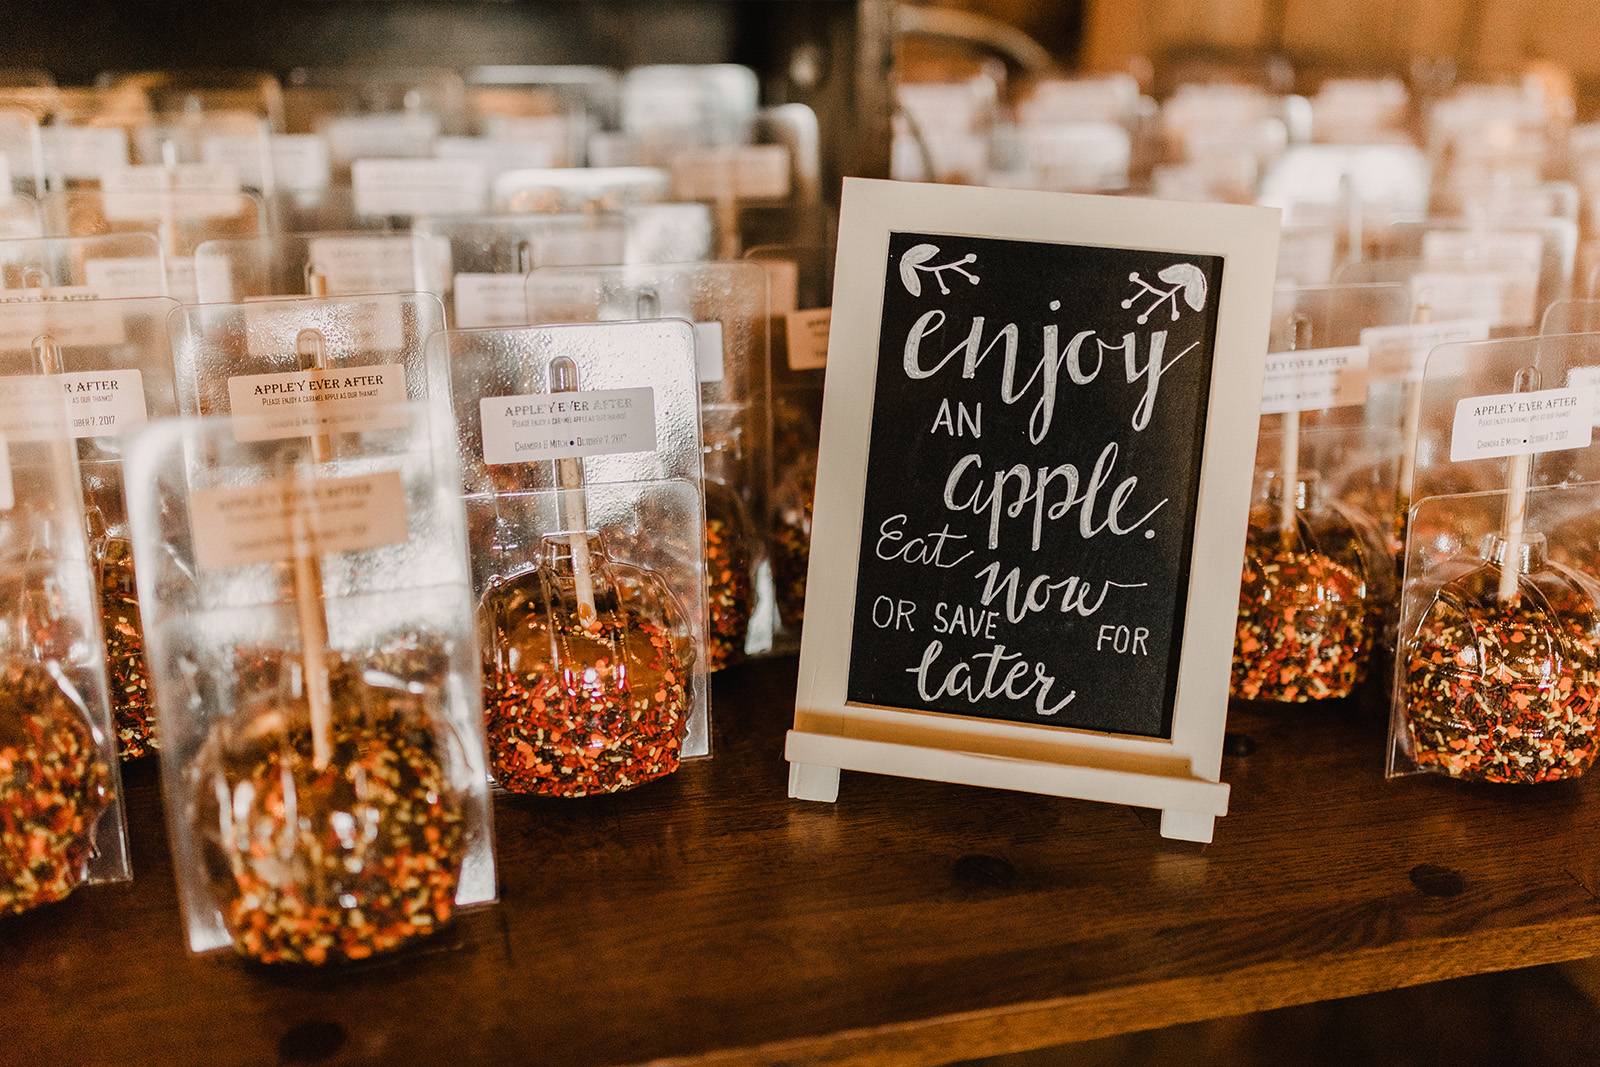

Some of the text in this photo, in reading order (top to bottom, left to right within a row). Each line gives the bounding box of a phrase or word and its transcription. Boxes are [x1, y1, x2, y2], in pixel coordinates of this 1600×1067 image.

[76, 380, 119, 392] AFTER
[254, 375, 384, 395] APPLE'Y EVER AFTER
[903, 300, 1200, 445] enjoy
[99, 415, 116, 426] 2017
[930, 398, 982, 439] AN
[1545, 397, 1577, 409] AFTER
[944, 441, 1169, 551] apple.
[875, 513, 975, 568] Eat
[974, 560, 1148, 624] now
[872, 595, 1150, 656] OR SAVE FOR
[906, 639, 1077, 716] later
